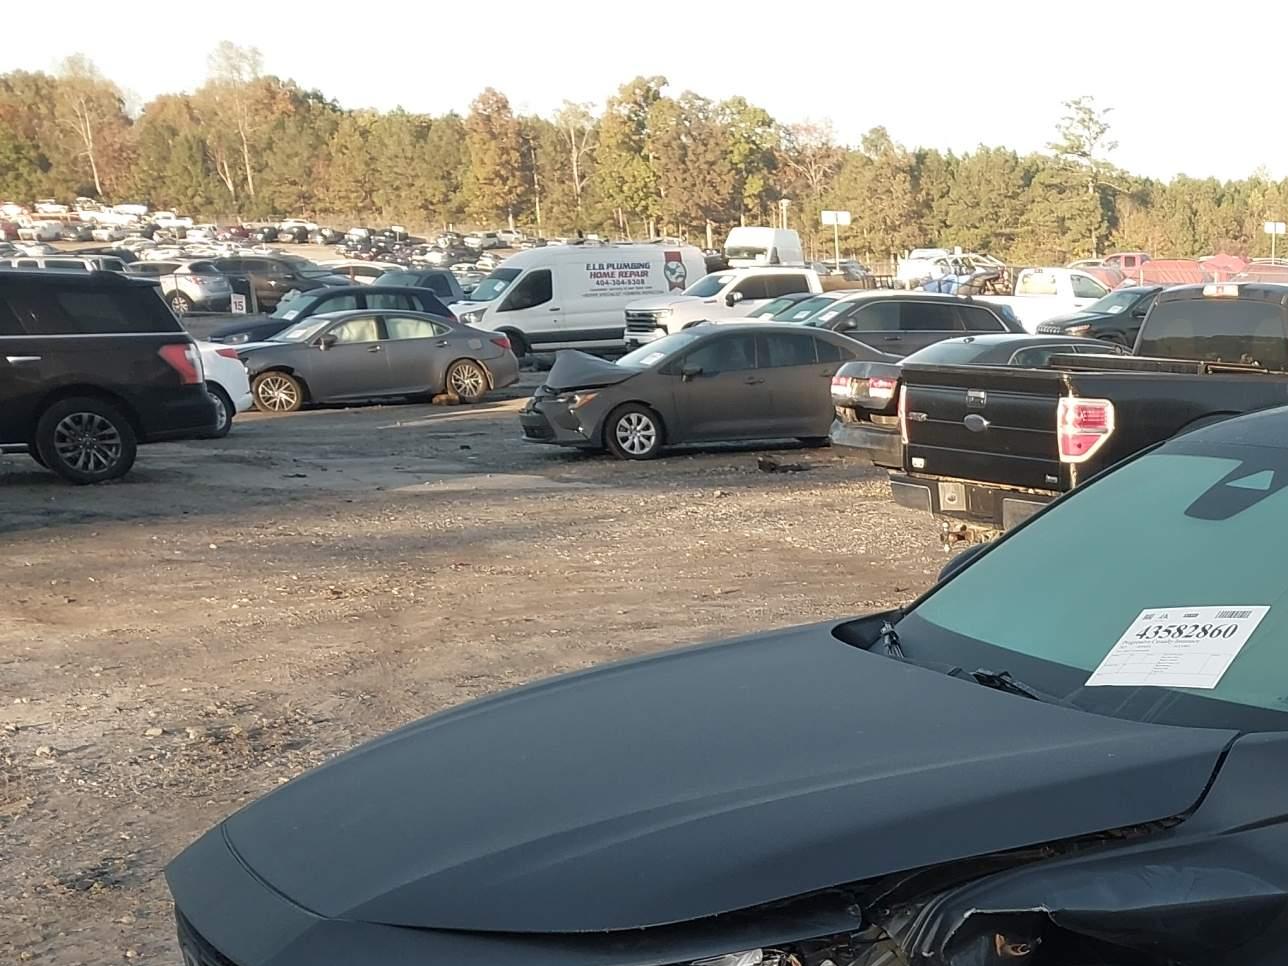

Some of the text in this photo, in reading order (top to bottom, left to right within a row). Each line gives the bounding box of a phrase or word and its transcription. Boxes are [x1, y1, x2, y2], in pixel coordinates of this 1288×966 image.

[606, 262, 651, 270] PLUMBING
[589, 270, 649, 279] HOME REPAIR
[234, 301, 243, 311] 15
[1136, 624, 1239, 639] 43582860
